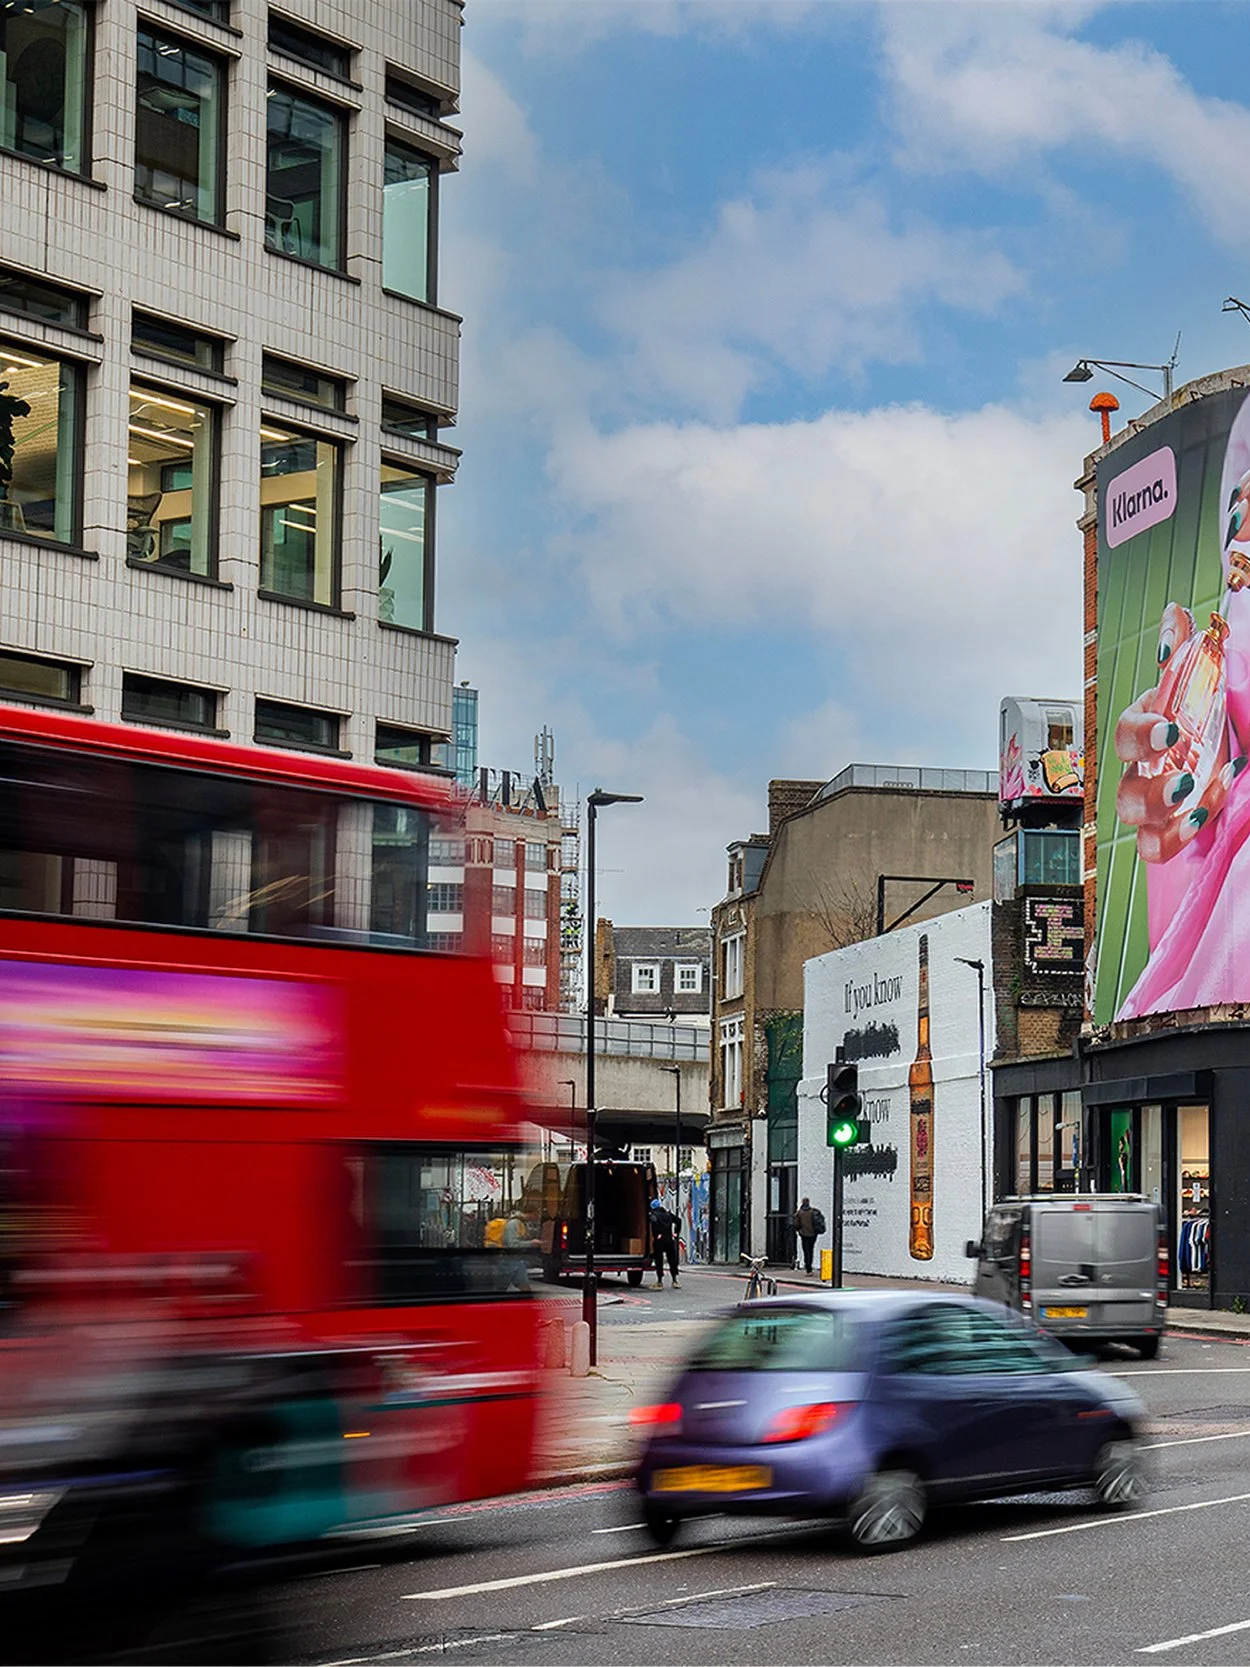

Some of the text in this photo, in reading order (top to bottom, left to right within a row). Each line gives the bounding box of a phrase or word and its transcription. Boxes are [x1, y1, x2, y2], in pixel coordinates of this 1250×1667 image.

[1112, 481, 1169, 528] Klarna.
[844, 972, 903, 1019] If you know
